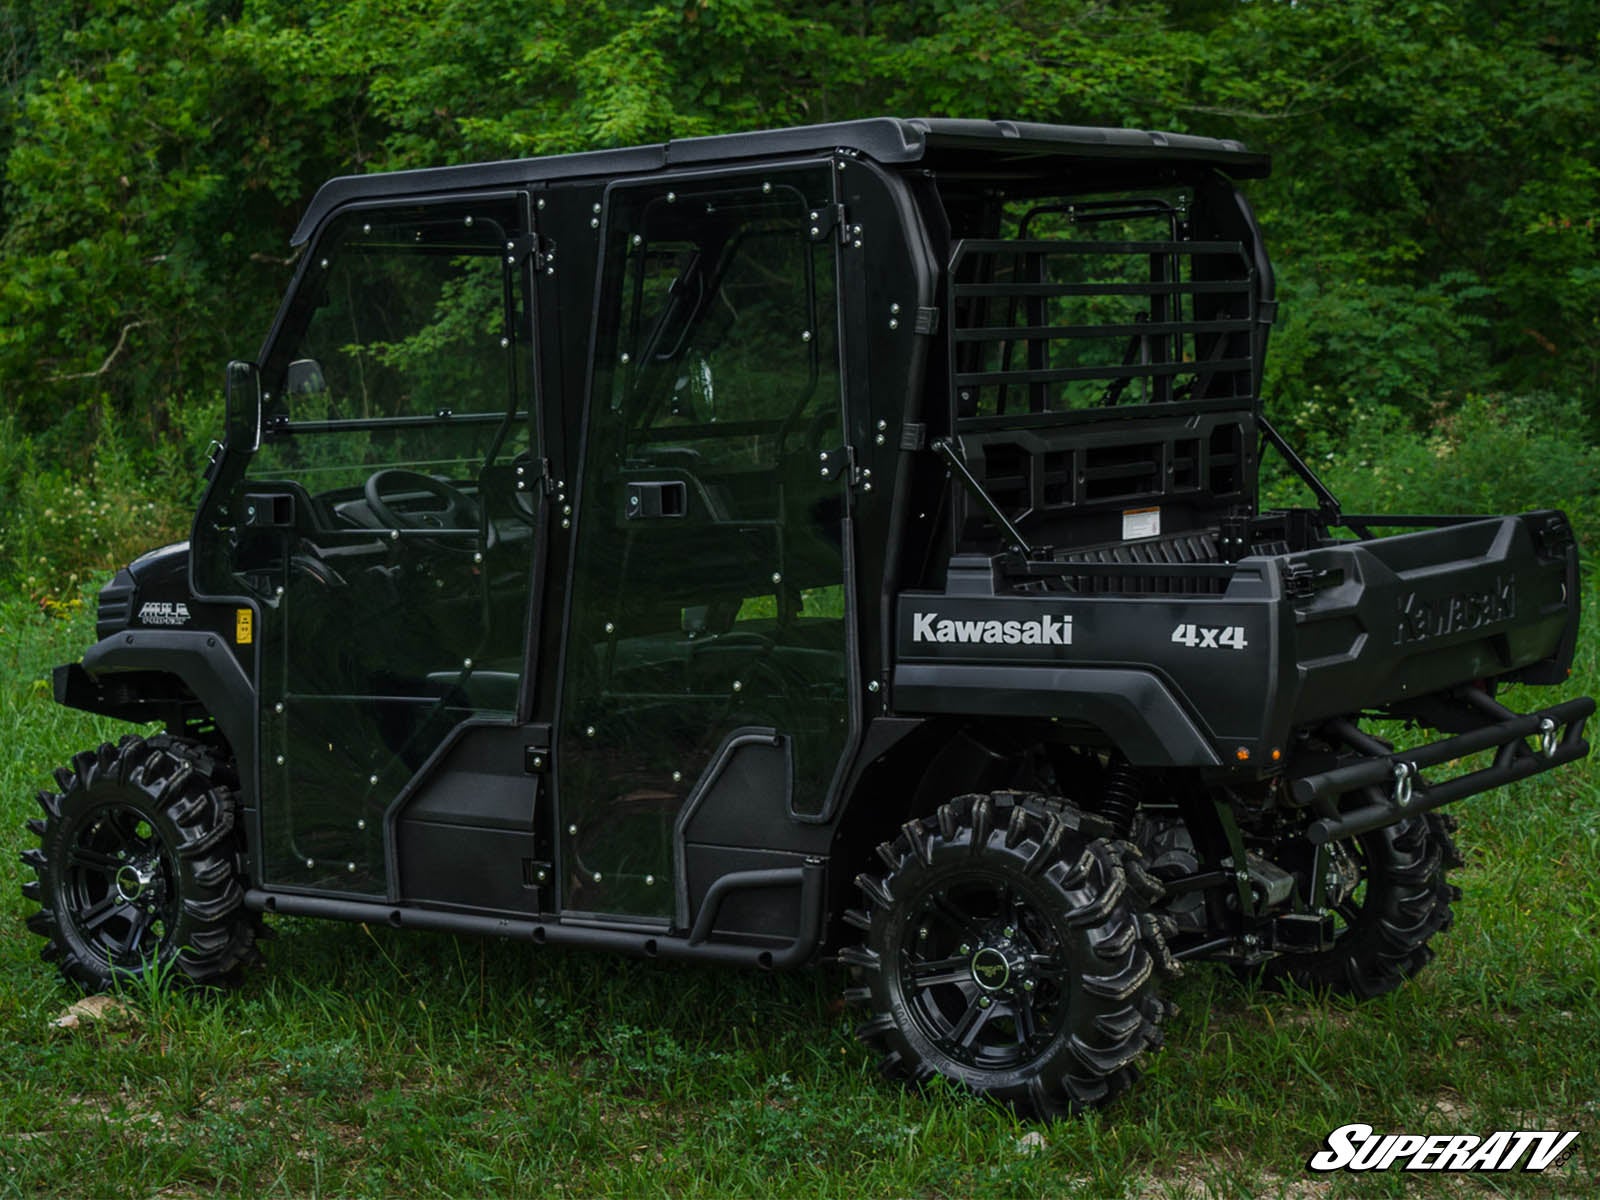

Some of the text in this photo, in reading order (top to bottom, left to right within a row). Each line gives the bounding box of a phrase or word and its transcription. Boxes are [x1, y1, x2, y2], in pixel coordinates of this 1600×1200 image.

[912, 612, 1248, 650] Kawasaki 4x4
[1394, 573, 1516, 646] Kawasaki
